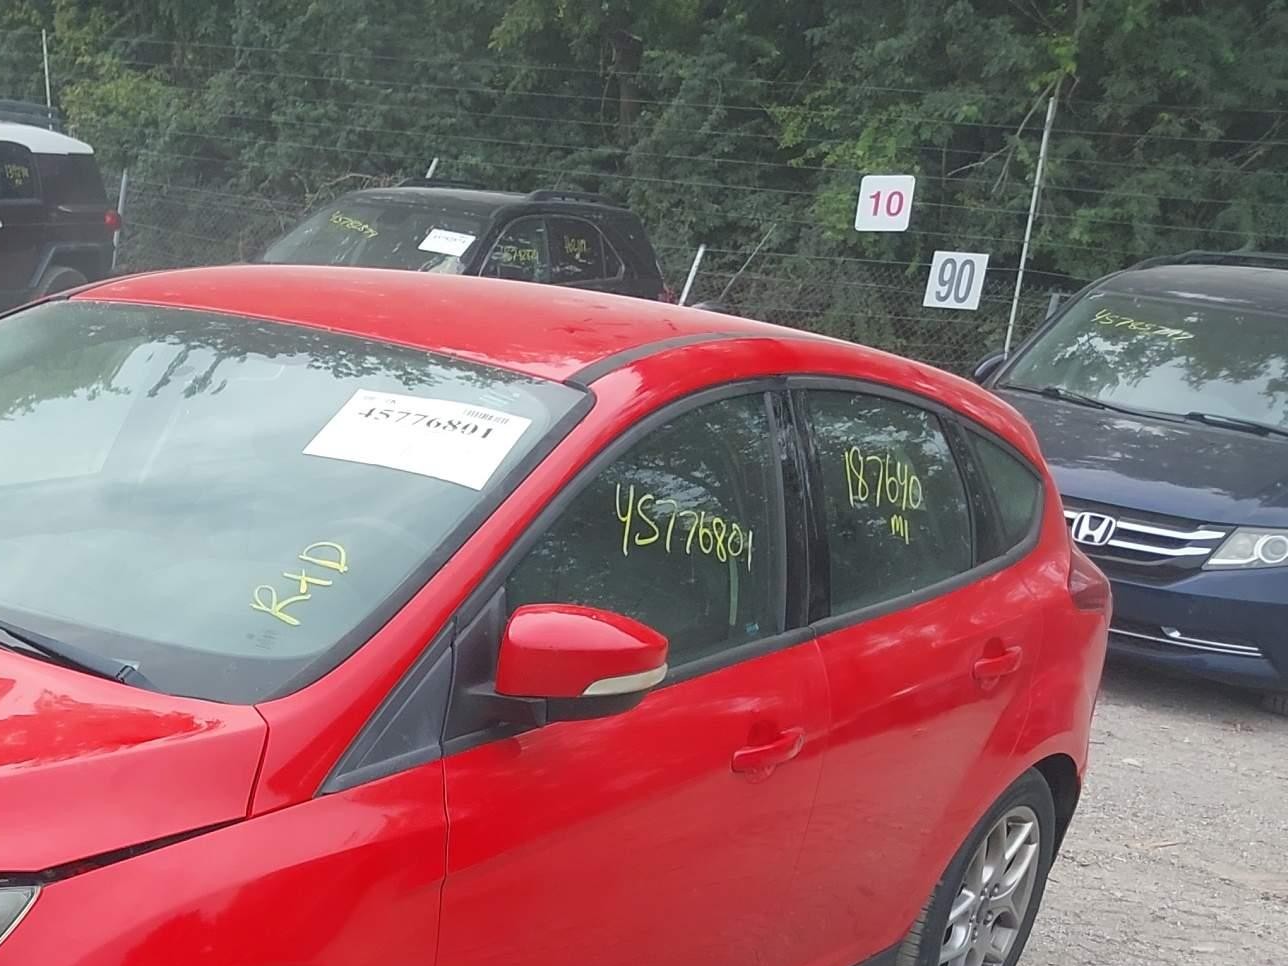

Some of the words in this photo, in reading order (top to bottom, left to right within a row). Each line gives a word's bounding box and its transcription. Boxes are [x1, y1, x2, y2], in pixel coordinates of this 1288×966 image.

[869, 190, 904, 217] 10
[935, 258, 975, 304] 90
[357, 407, 494, 440] 45776801
[844, 446, 922, 511] 187640
[616, 483, 753, 573] 45776801
